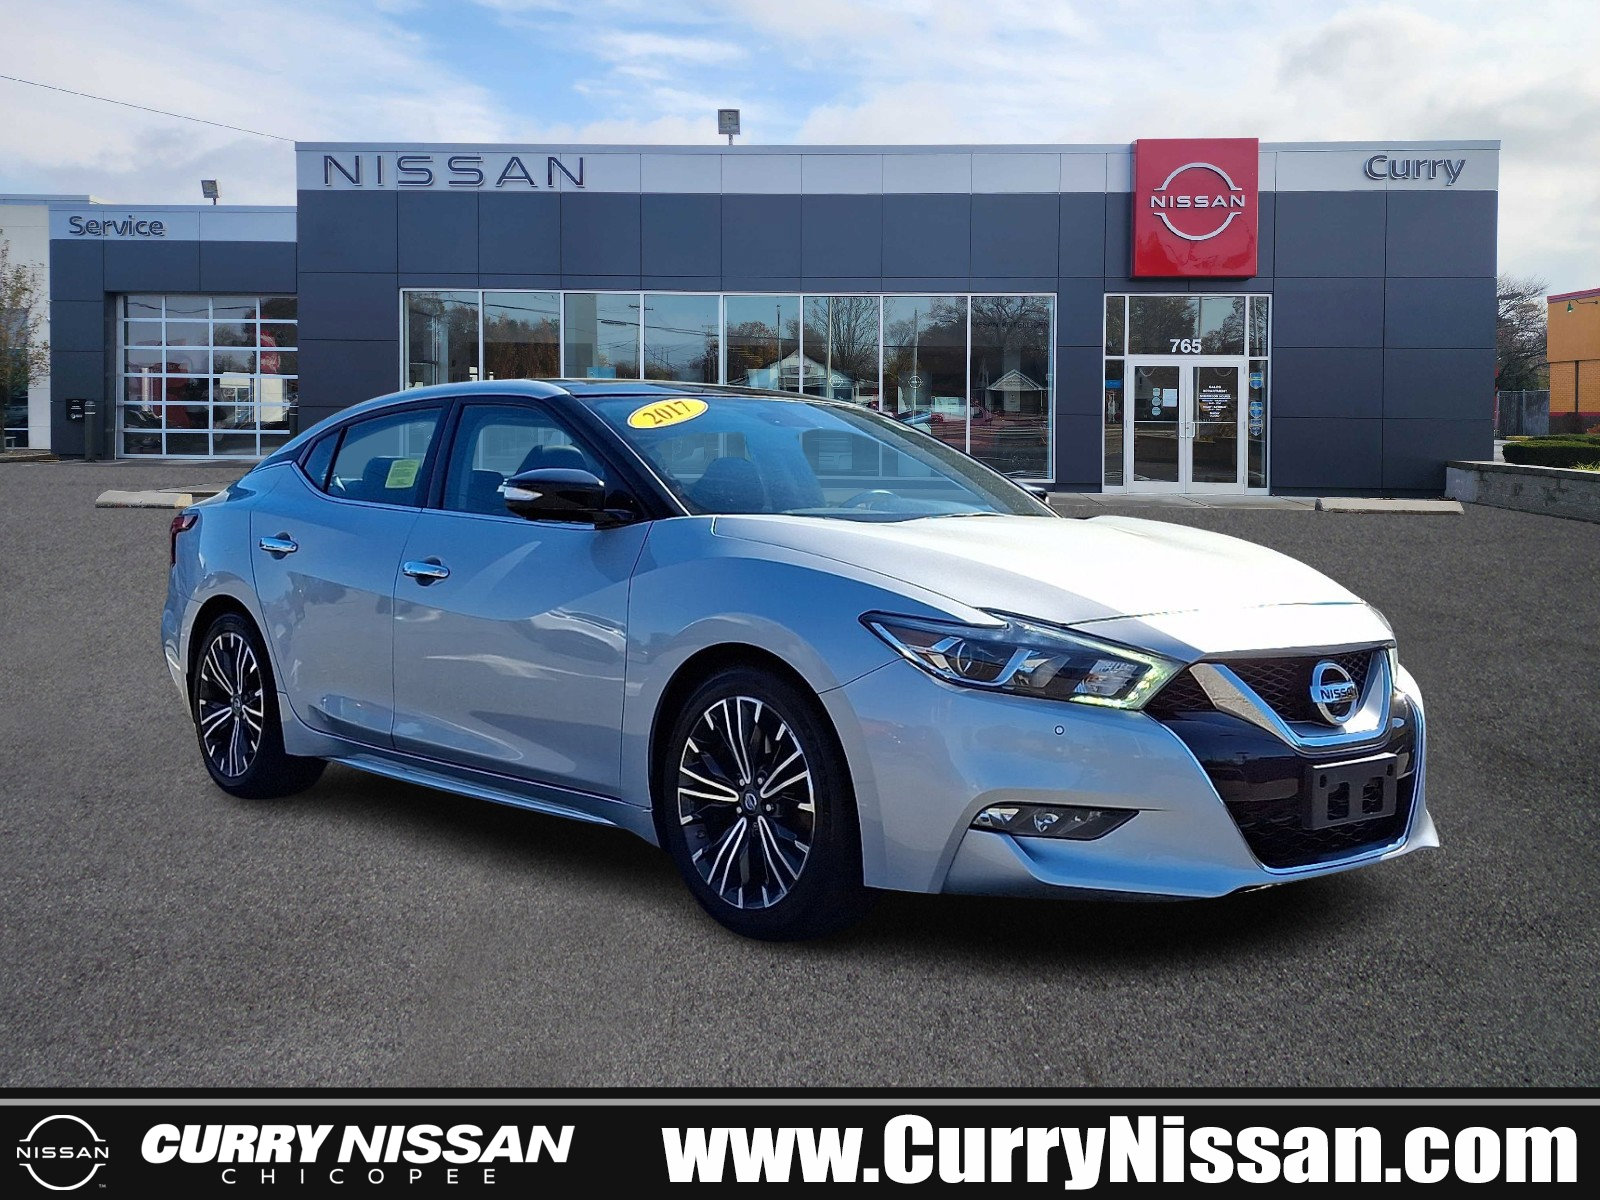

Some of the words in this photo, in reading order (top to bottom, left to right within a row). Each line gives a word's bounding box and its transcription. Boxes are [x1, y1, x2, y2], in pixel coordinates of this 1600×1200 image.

[324, 155, 586, 188] NISSAN
[1364, 155, 1466, 187] Curry
[1150, 195, 1245, 208] NISSAN
[69, 214, 166, 237] Service
[1170, 338, 1203, 354] 765
[642, 401, 692, 425] 2017
